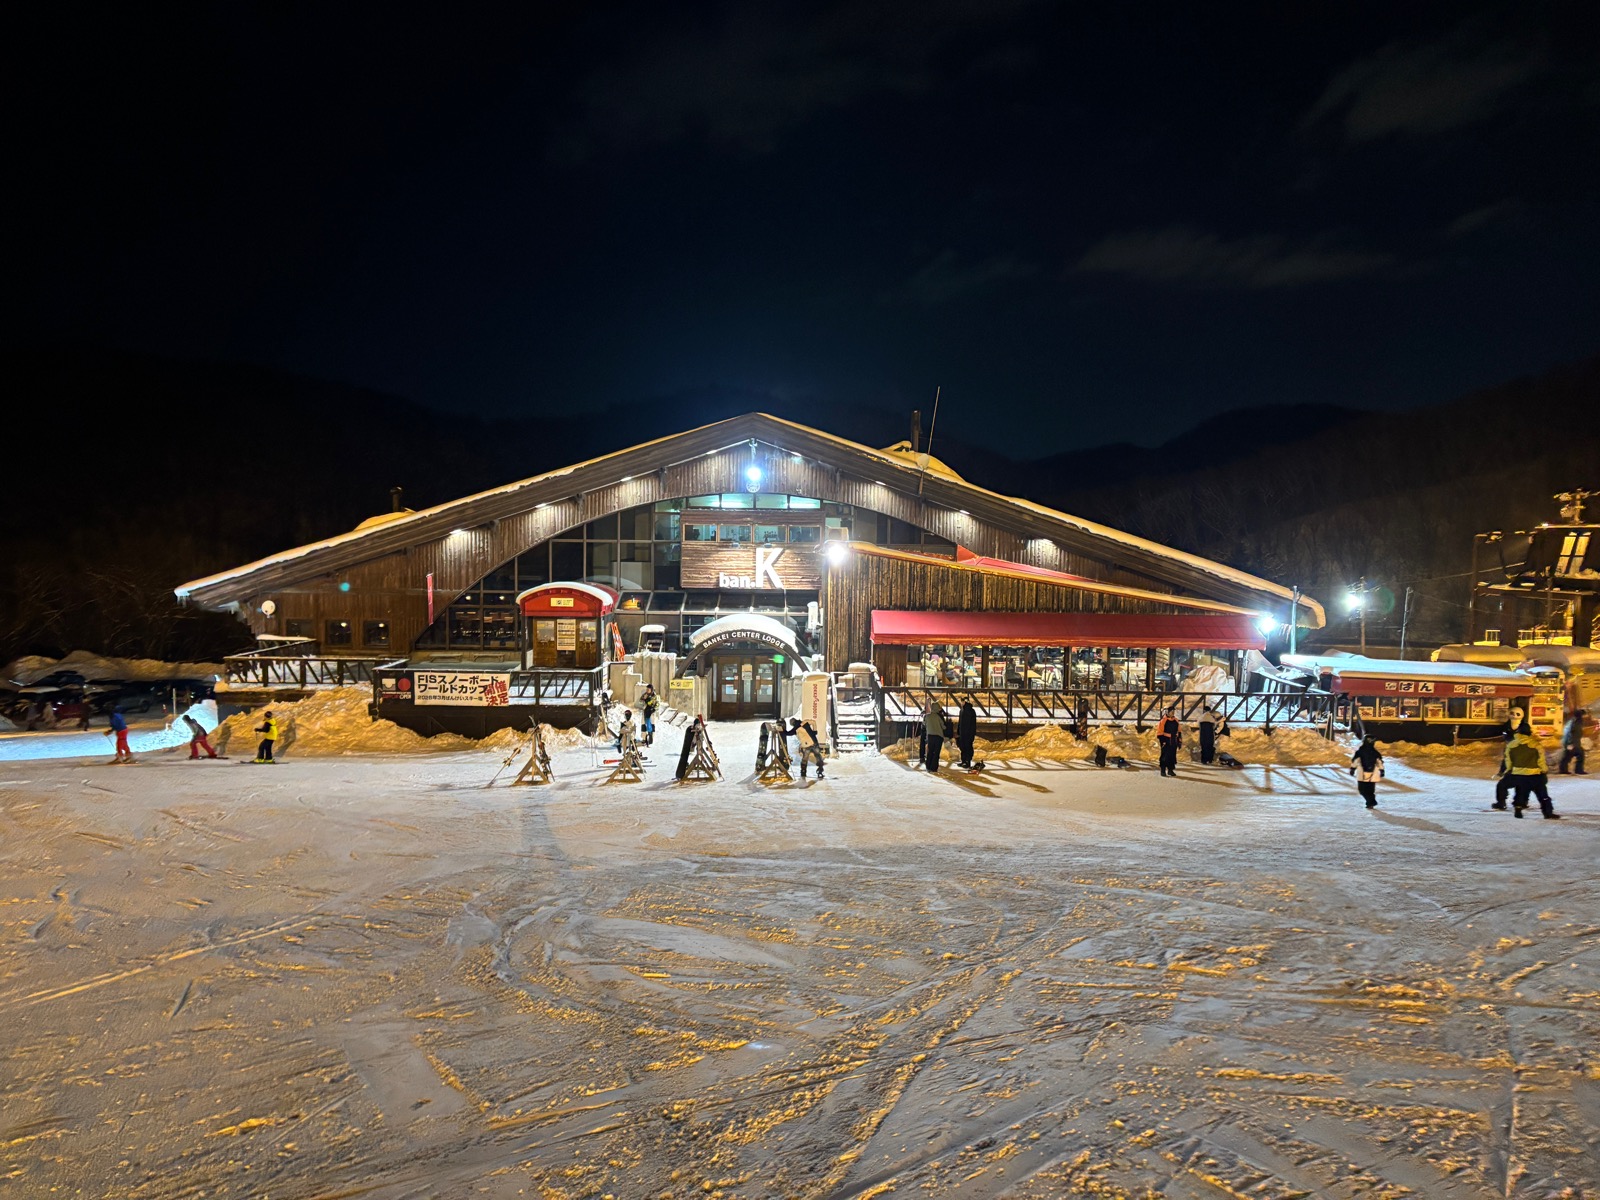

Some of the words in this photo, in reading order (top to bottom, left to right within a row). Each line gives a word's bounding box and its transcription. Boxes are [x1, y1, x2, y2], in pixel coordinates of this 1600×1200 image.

[702, 633, 729, 648] BANKEI
[731, 631, 760, 639] CENTER
[762, 634, 786, 649] LODGE
[417, 674, 499, 685] FISスノーボード
